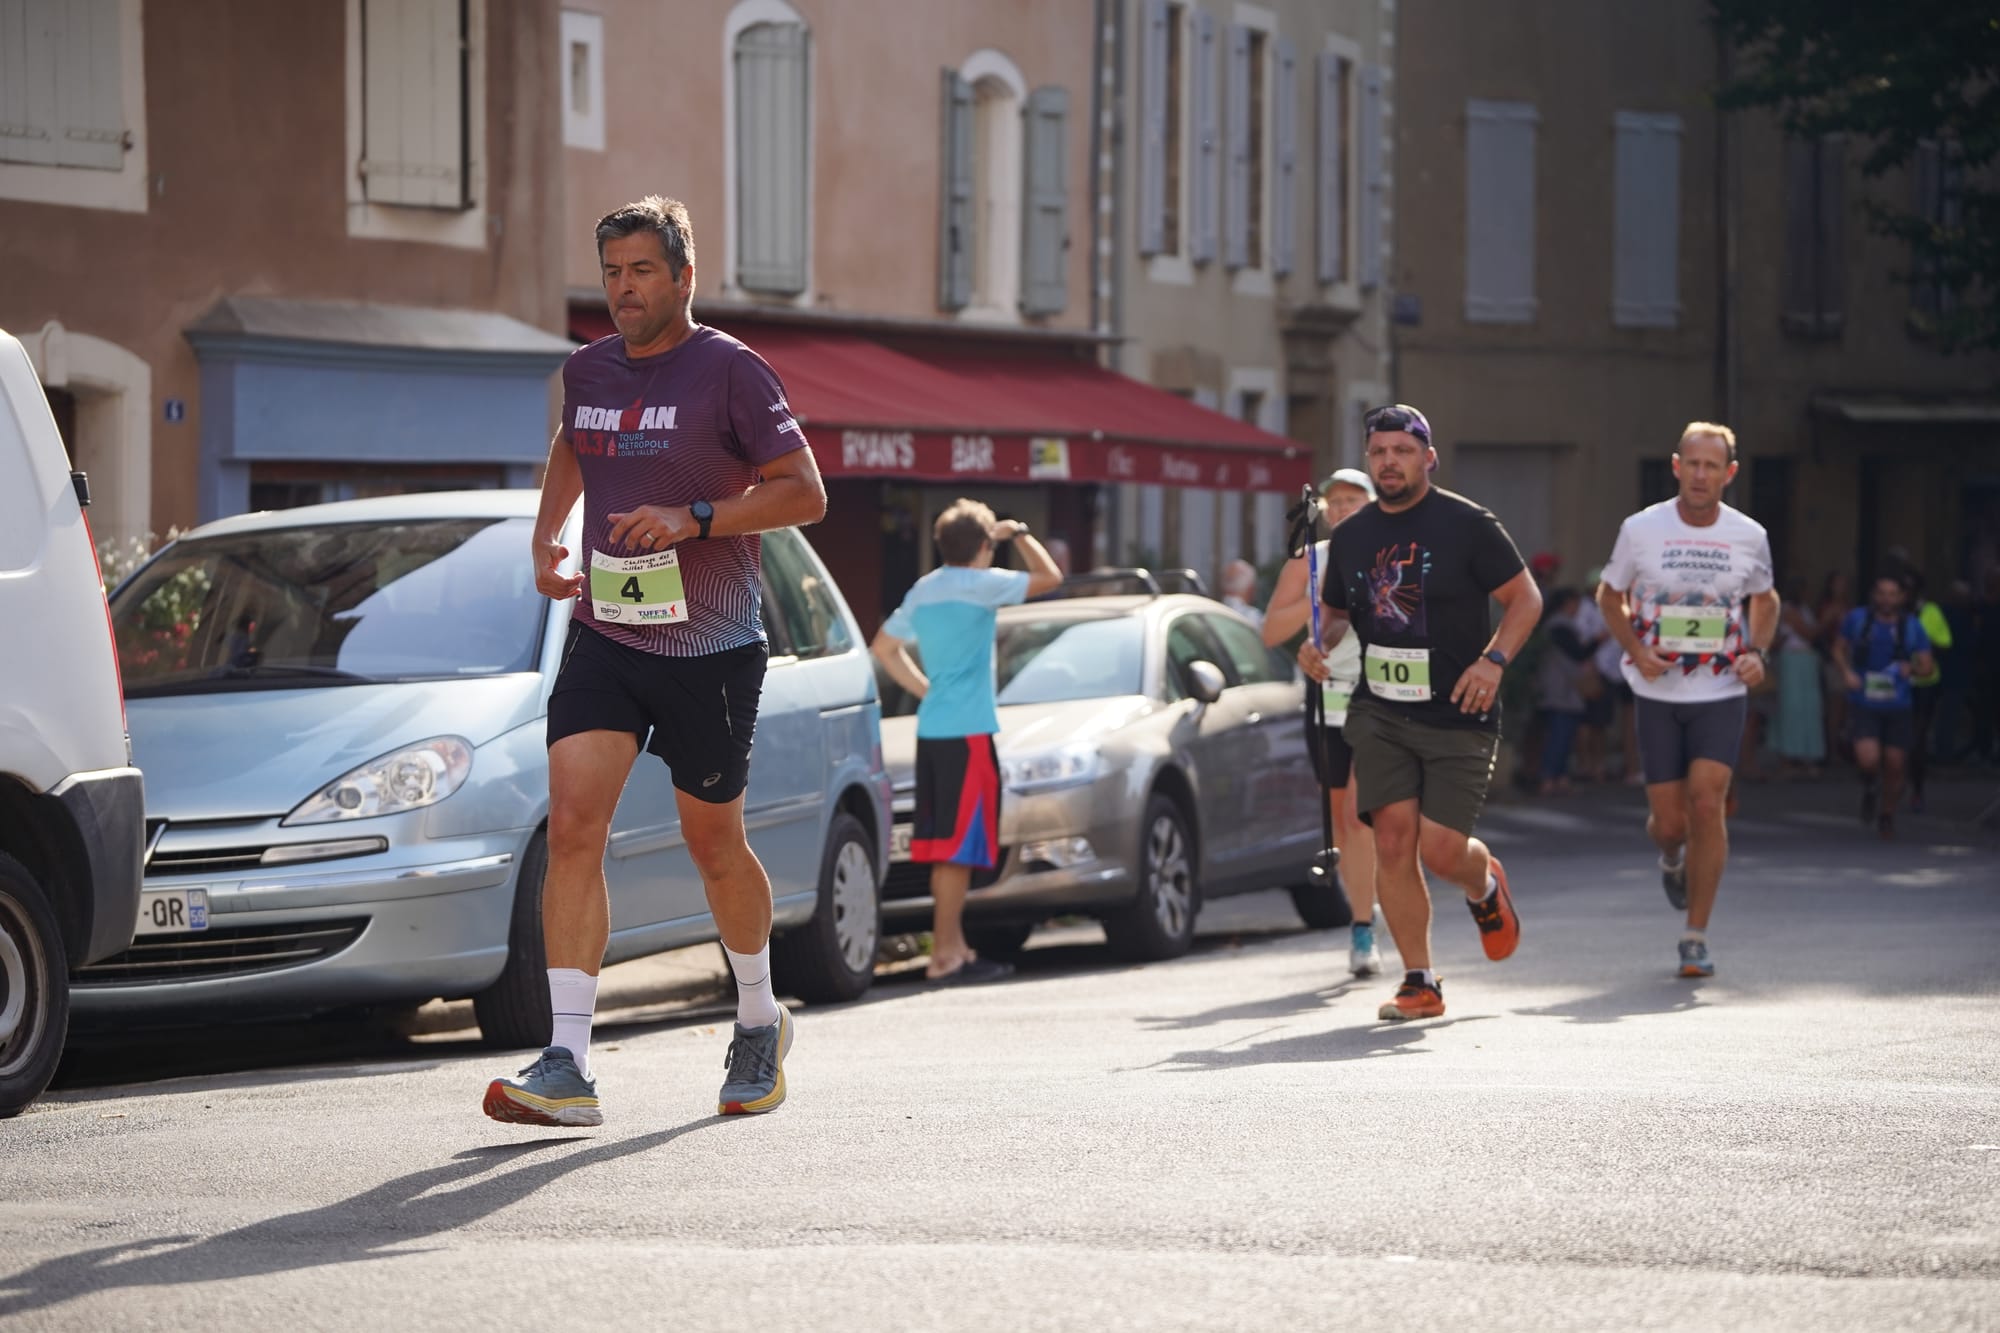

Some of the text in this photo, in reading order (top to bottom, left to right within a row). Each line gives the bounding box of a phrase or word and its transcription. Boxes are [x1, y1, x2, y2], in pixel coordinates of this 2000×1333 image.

[574, 400, 676, 431] IRONMAN
[619, 432, 645, 442] TOURS
[636, 448, 659, 456] VALLEY
[842, 431, 994, 471] RYAN'S BAR
[620, 576, 644, 602] 4
[637, 608, 668, 617] TUFF'S
[1686, 619, 1700, 637] 2
[1380, 661, 1409, 684] 10
[190, 909, 205, 923] 59
